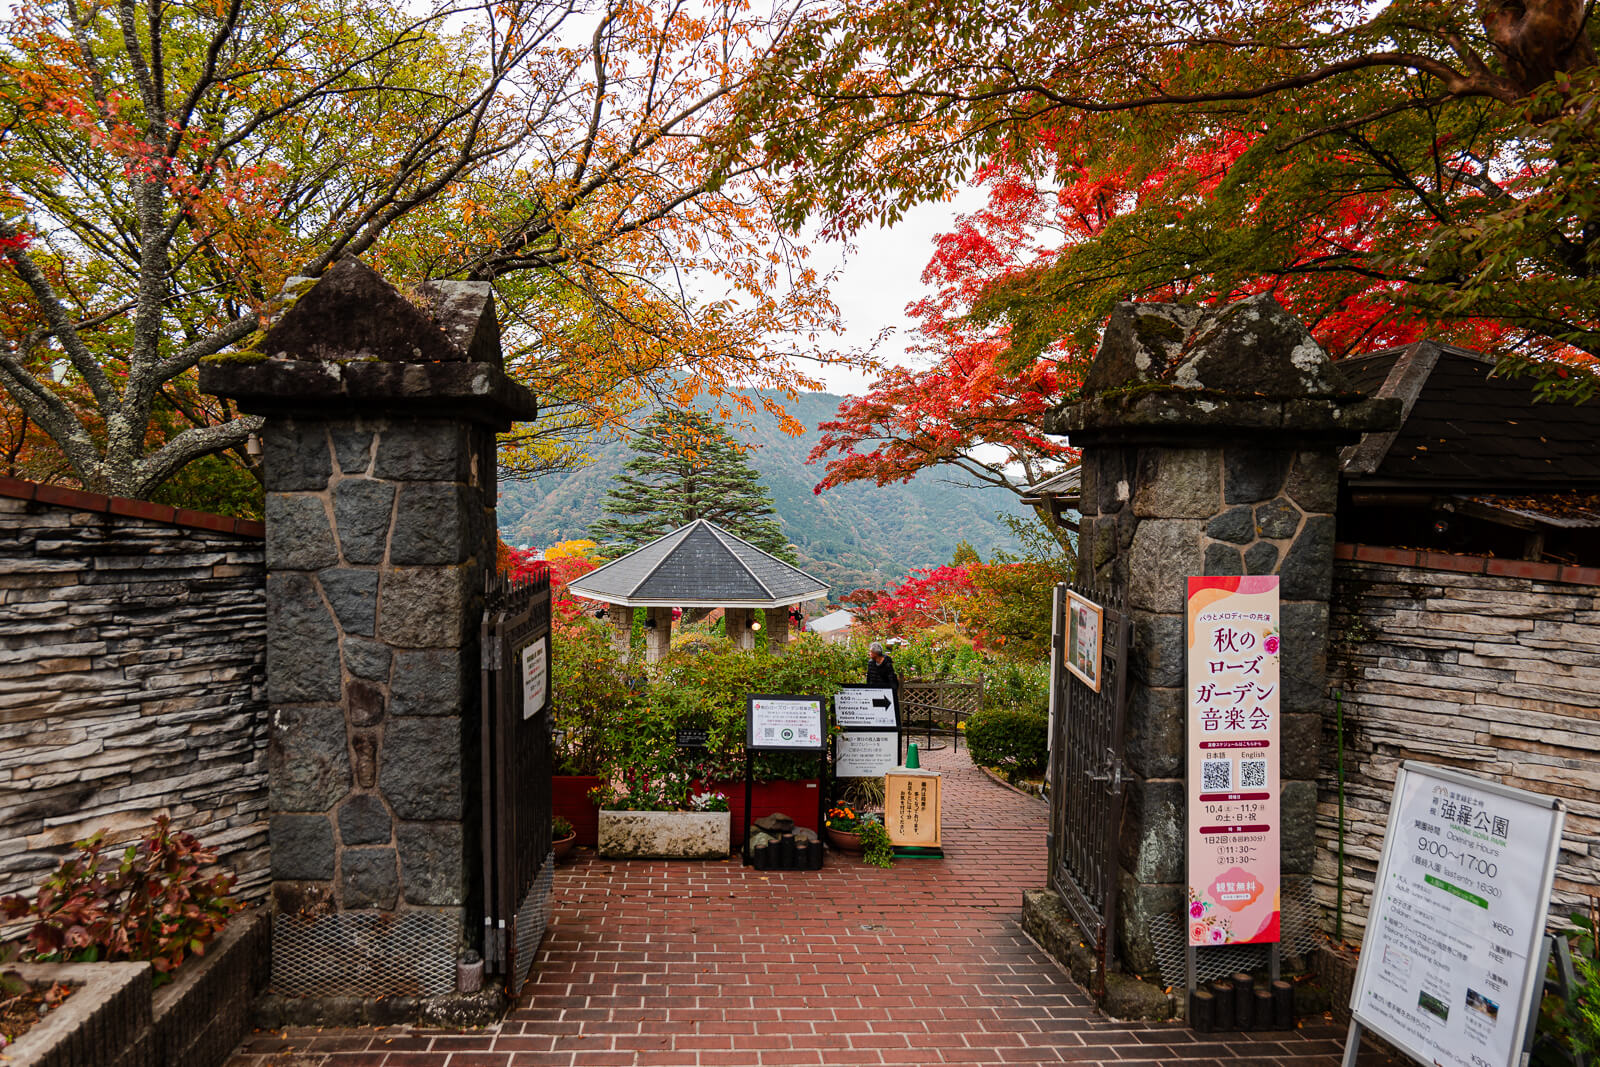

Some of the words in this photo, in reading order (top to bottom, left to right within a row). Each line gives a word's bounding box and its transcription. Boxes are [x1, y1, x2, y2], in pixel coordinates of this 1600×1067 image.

[1200, 612, 1270, 621] バラとメロディーの共演
[1213, 627, 1255, 653] 秋の
[1209, 655, 1264, 675] ローズ
[1196, 681, 1275, 704] ガーデン
[1201, 706, 1270, 731] 音楽会
[1241, 751, 1265, 759] English
[1414, 819, 1440, 835] 開園時間
[1439, 798, 1509, 839] 強羅公園
[1446, 830, 1475, 849] Opening
[1475, 842, 1499, 857] Hours
[1449, 823, 1471, 835] HAKONE
[1472, 830, 1488, 841] GORA
[1489, 836, 1507, 848] PARK
[1417, 836, 1498, 879] 9:00～17:00
[1216, 880, 1256, 893] 観覧無料
[1390, 905, 1411, 919] Children
[1491, 920, 1514, 937] ¥650
[1487, 950, 1504, 964] FREE
[1484, 978, 1500, 992] FREE
